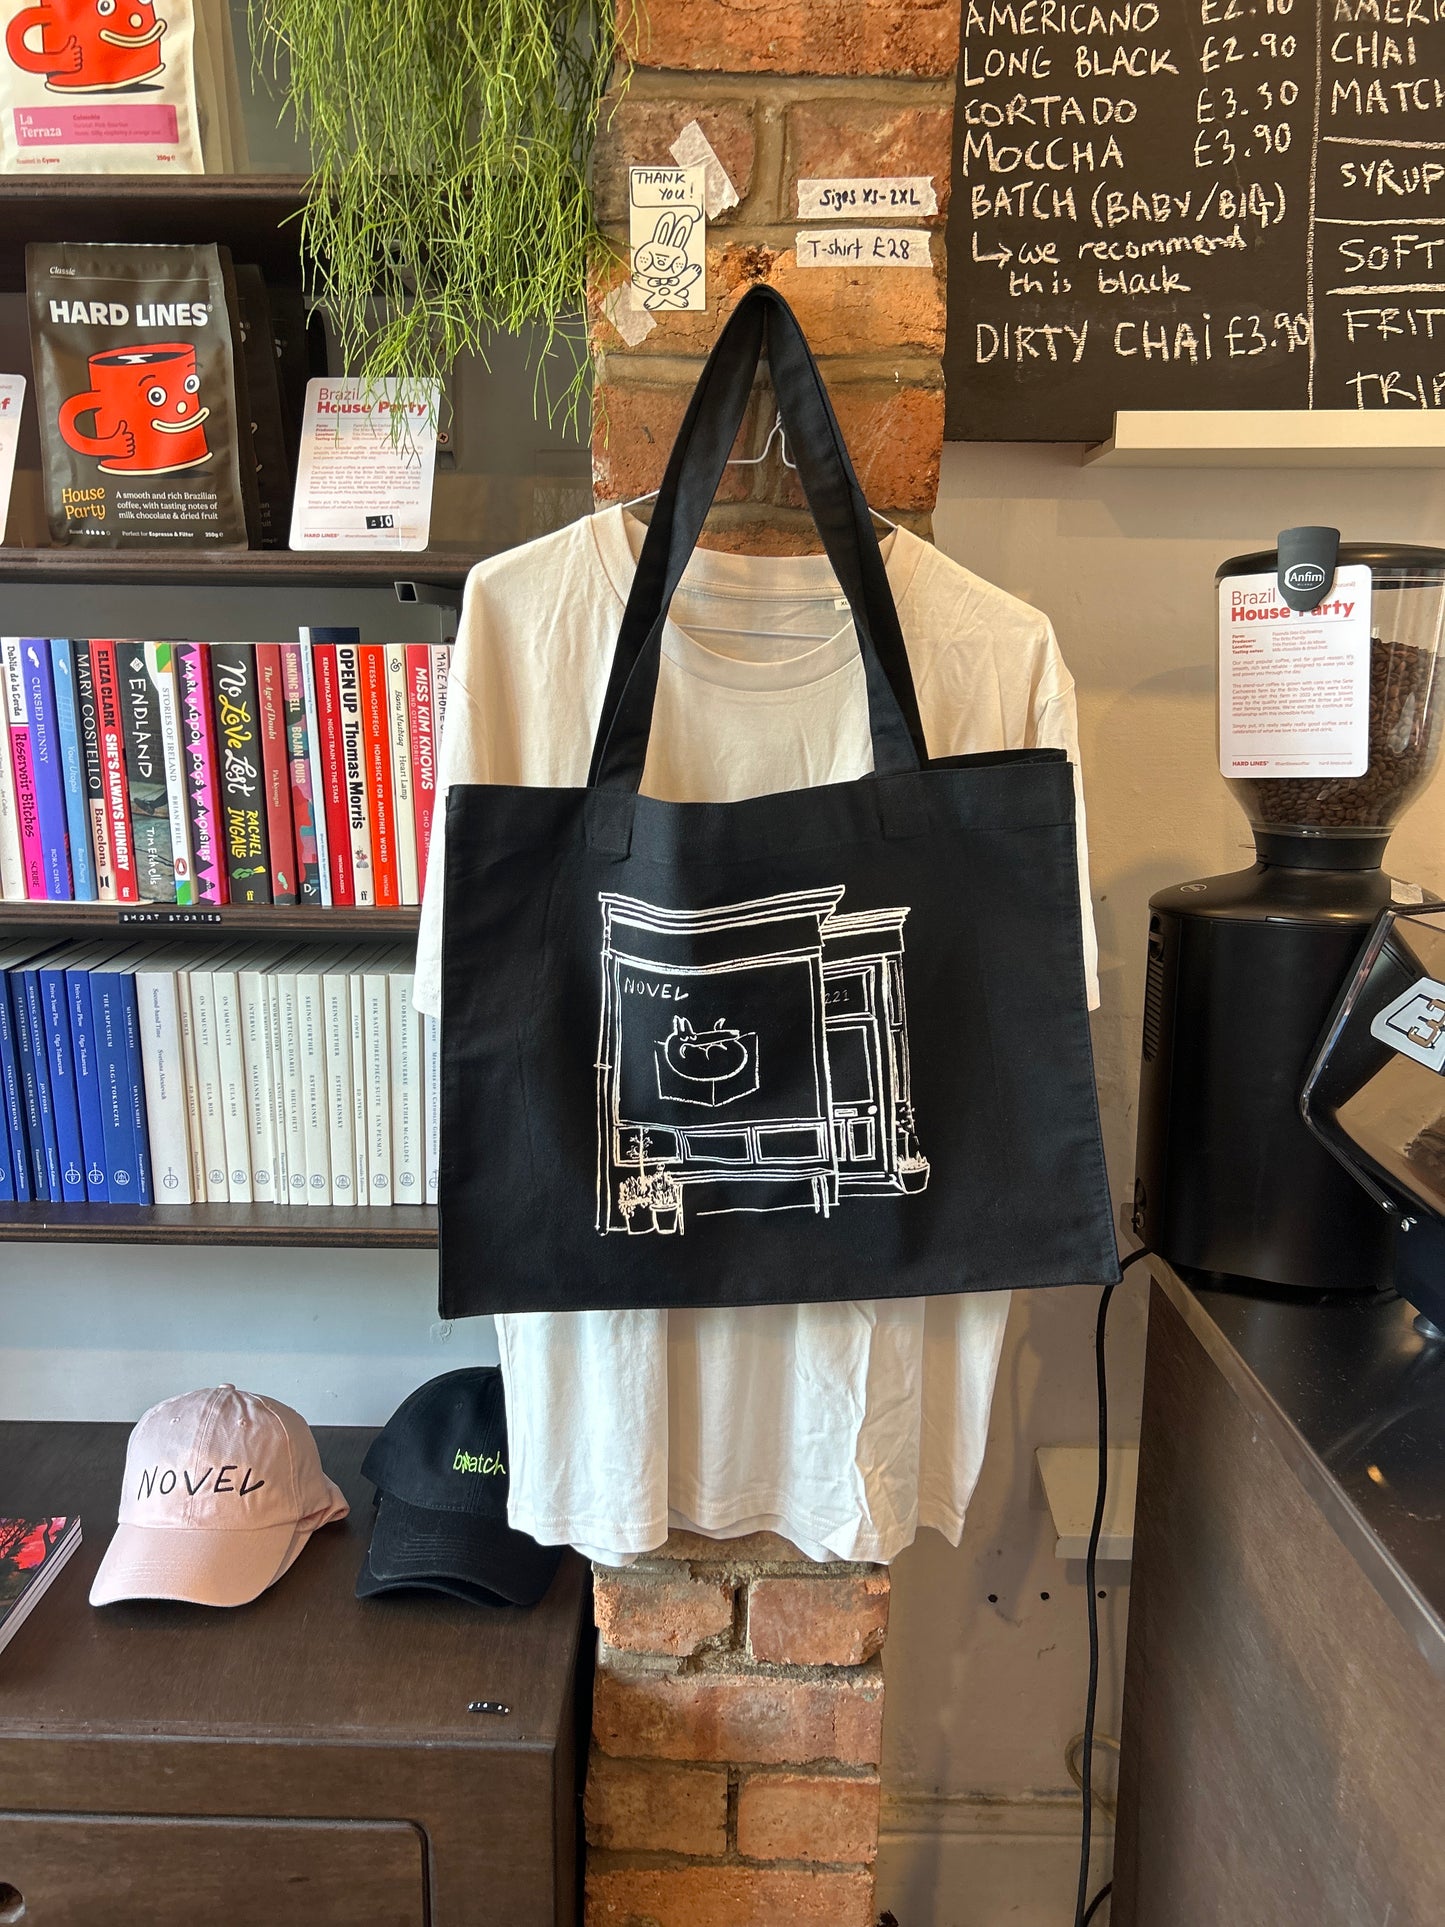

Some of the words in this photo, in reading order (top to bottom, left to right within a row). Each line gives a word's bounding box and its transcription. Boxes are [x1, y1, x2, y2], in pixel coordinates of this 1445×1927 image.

[965, 0, 1160, 37] AMERICANO
[964, 46, 1052, 87] LONG
[1074, 46, 1180, 79] BLACK
[1199, 33, 1297, 74] £2.90
[1331, 31, 1417, 69] CHAI
[19, 113, 33, 126] La
[964, 93, 1138, 128] CORTADO
[20, 126, 63, 138] Terraza
[963, 129, 1124, 178] MOCCHA
[1193, 122, 1292, 168] £3.90
[634, 171, 686, 184] THANK
[659, 182, 695, 201] YOU!
[971, 181, 1078, 222] BATCH
[807, 237, 863, 259] T-shirt
[873, 236, 910, 260] £28
[1017, 241, 1060, 265] we
[1078, 223, 1248, 261] recommend
[49, 266, 76, 276] Classic
[1010, 269, 1073, 297] this
[1098, 265, 1192, 295] black
[49, 300, 129, 327] HARD
[976, 319, 1089, 364] DIRTY
[1224, 312, 1310, 358] £3.90
[316, 401, 372, 414] House
[318, 387, 360, 400] Brazil
[62, 487, 106, 504] House
[64, 503, 106, 521] Party
[115, 491, 122, 499] A
[123, 491, 151, 500] smooth
[151, 491, 167, 500] and
[167, 491, 182, 500] rich
[184, 491, 218, 500] Brazilian
[117, 501, 142, 511] coffee,
[142, 501, 160, 510] with
[160, 502, 187, 511] tasting
[187, 502, 209, 511] notes
[209, 501, 218, 511] of
[118, 511, 136, 519] milk
[136, 511, 172, 520] chocolate
[172, 512, 180, 520] &
[180, 511, 200, 520] dried
[200, 511, 219, 521] fruit
[1289, 571, 1323, 583] Anfim
[1231, 588, 1276, 606] Brazil
[1231, 606, 1291, 622] House
[1298, 600, 1355, 618] arty
[76, 653, 93, 699] MARY
[97, 650, 112, 685] ELIZA
[184, 660, 197, 694] MARK
[217, 660, 247, 698] No
[264, 665, 273, 683] The
[286, 652, 299, 690] SINKING
[339, 648, 356, 690] OPEN
[368, 653, 377, 689] OTTESSA
[436, 651, 448, 683] MAKE
[31, 677, 44, 721] CURSED
[263, 686, 274, 702] Age
[323, 680, 332, 714] MIYAZAWA
[415, 667, 429, 703] MISS
[100, 687, 115, 728] CLARK
[162, 688, 172, 726] STORIES
[264, 702, 275, 713] of
[289, 692, 301, 713] BELL
[342, 692, 358, 714] UP
[370, 691, 379, 737] MOSHFEGH
[417, 705, 430, 733] KIM
[129, 678, 153, 778] ENDLAND
[166, 727, 174, 740] OF
[188, 697, 201, 746] HADDON
[218, 694, 253, 749] Love
[267, 713, 277, 740] Doubt
[36, 724, 49, 764] BUNNY
[81, 704, 102, 790] COSTELLO
[105, 733, 120, 770] SHE'S
[291, 726, 304, 757] BOJAN
[344, 720, 360, 779] Thomas
[412, 735, 420, 766] STORIES
[15, 733, 32, 791] Reservoir
[167, 742, 177, 782] IRELAND
[192, 753, 205, 786] DOGS
[224, 748, 257, 797] Lost
[293, 758, 306, 784] LOUIS
[330, 761, 337, 770] TO
[374, 744, 383, 782] HOMESICK
[399, 755, 407, 778] Heart
[419, 735, 434, 790] KNOWS
[108, 770, 124, 820] ALWAYS
[332, 784, 340, 804] STARS
[349, 781, 366, 829] Morris
[400, 779, 408, 800] Lamp
[21, 792, 37, 838] Bitches
[377, 800, 386, 835] ANOTHER
[94, 808, 107, 867] Barcelona
[113, 822, 129, 871] HUNGRY
[197, 809, 211, 861] MONSTERS
[247, 810, 262, 857] RACHEL
[379, 837, 388, 863] WORLD
[123, 913, 160, 921] SHORT
[168, 914, 221, 922] STORIES
[624, 976, 689, 1000] NOVEL
[137, 1465, 266, 1501] NOVEL
